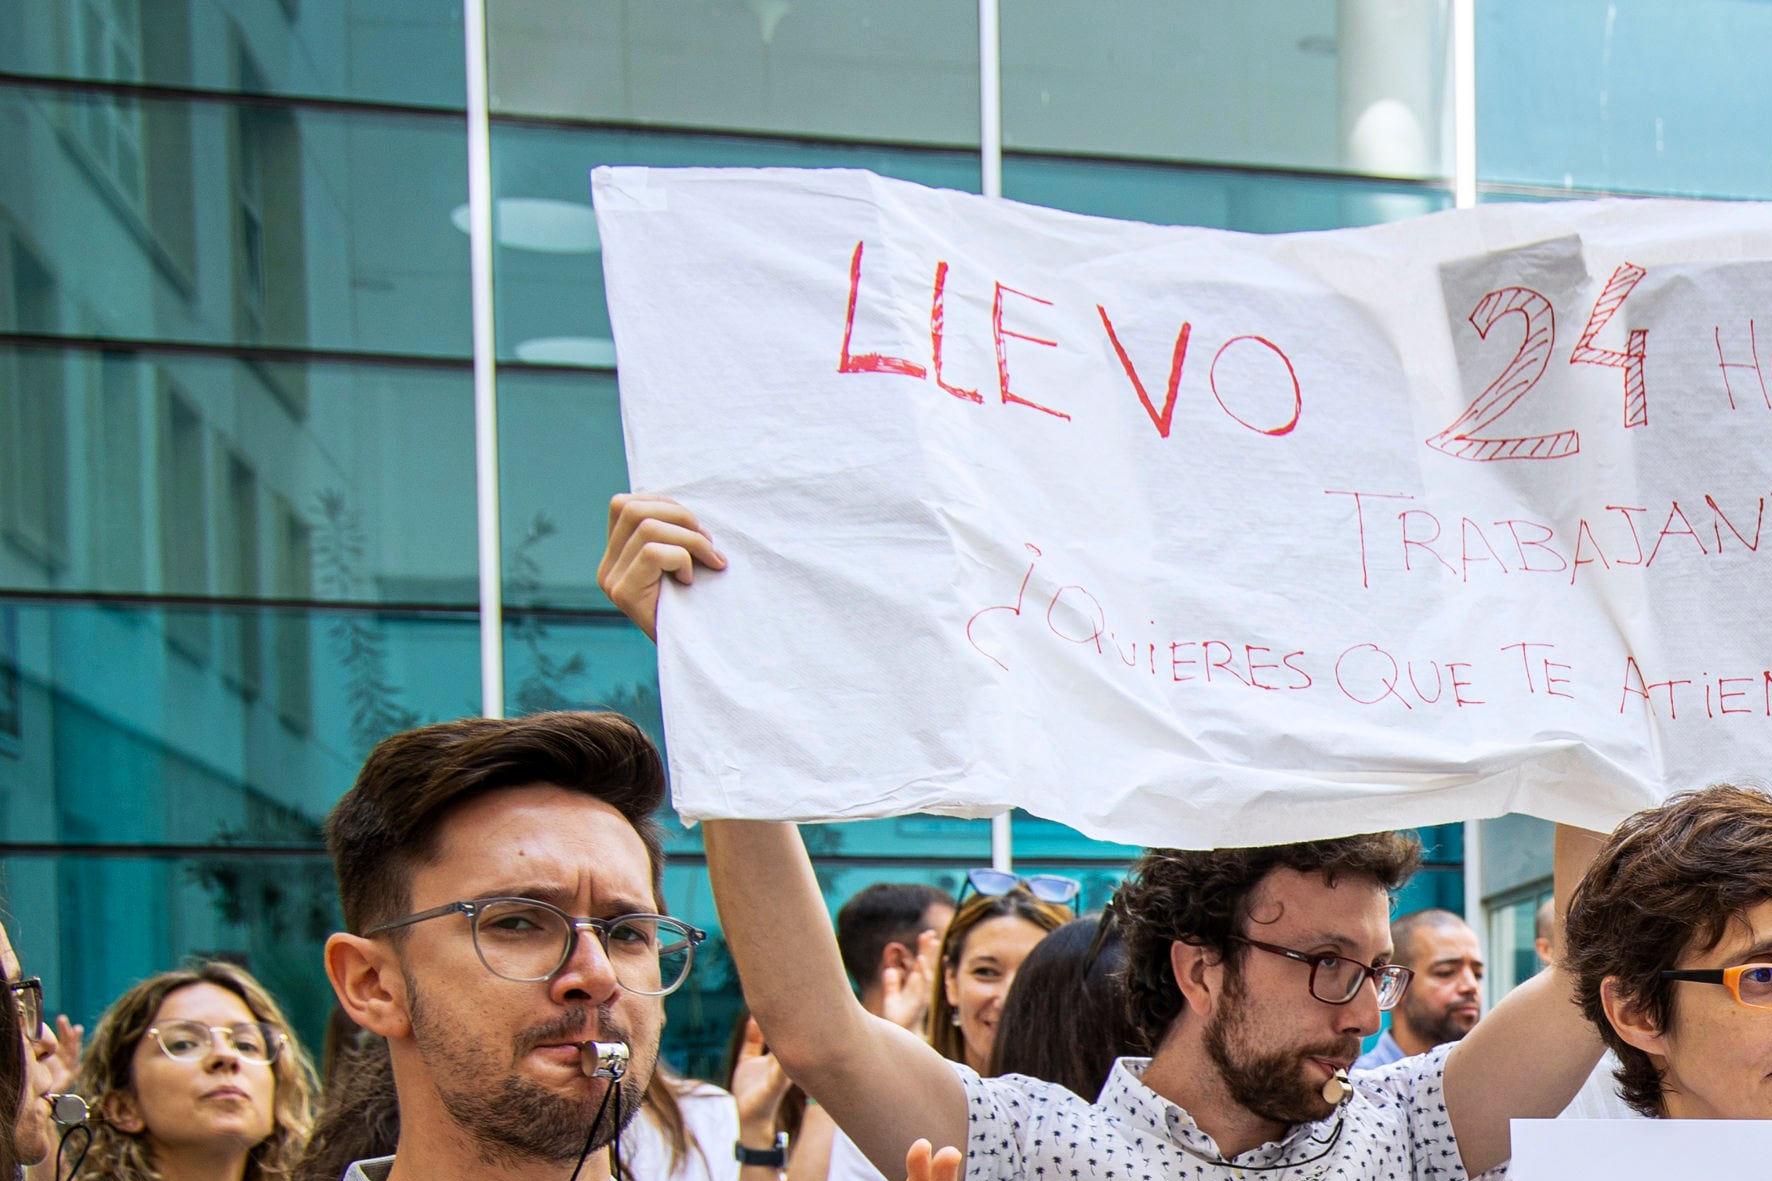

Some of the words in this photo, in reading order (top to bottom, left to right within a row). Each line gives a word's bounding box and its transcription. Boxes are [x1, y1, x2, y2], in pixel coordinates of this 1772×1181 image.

[837, 240, 1303, 438] LLEVO
[1425, 262, 1649, 462] 24
[1334, 642, 1486, 711] QUE
[1501, 641, 1576, 702] TE
